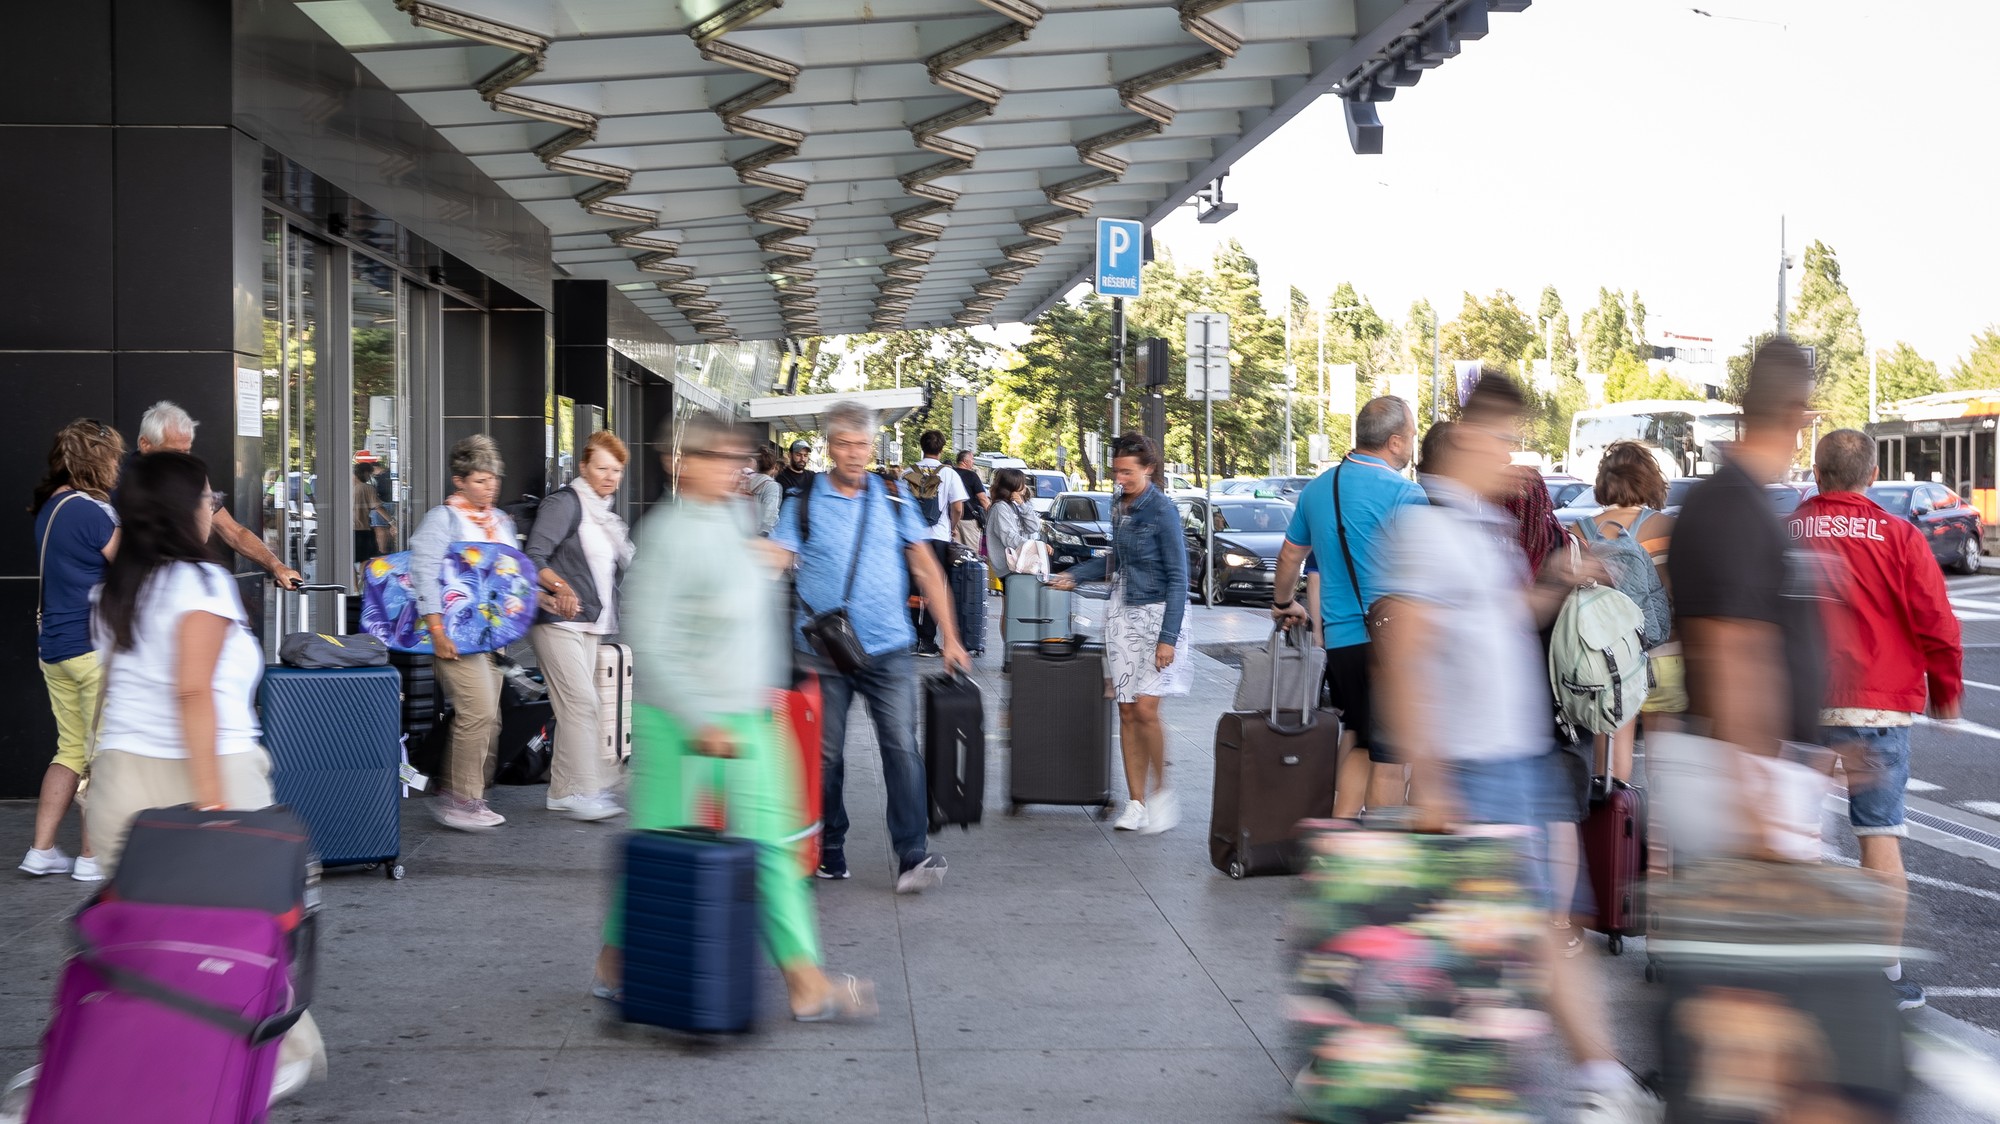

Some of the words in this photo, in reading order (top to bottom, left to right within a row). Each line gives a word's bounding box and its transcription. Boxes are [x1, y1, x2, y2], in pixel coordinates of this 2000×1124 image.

[1109, 225, 1131, 268] P
[1102, 274, 1137, 290] RÉSERVÉ
[1788, 515, 1885, 541] DIESEL
